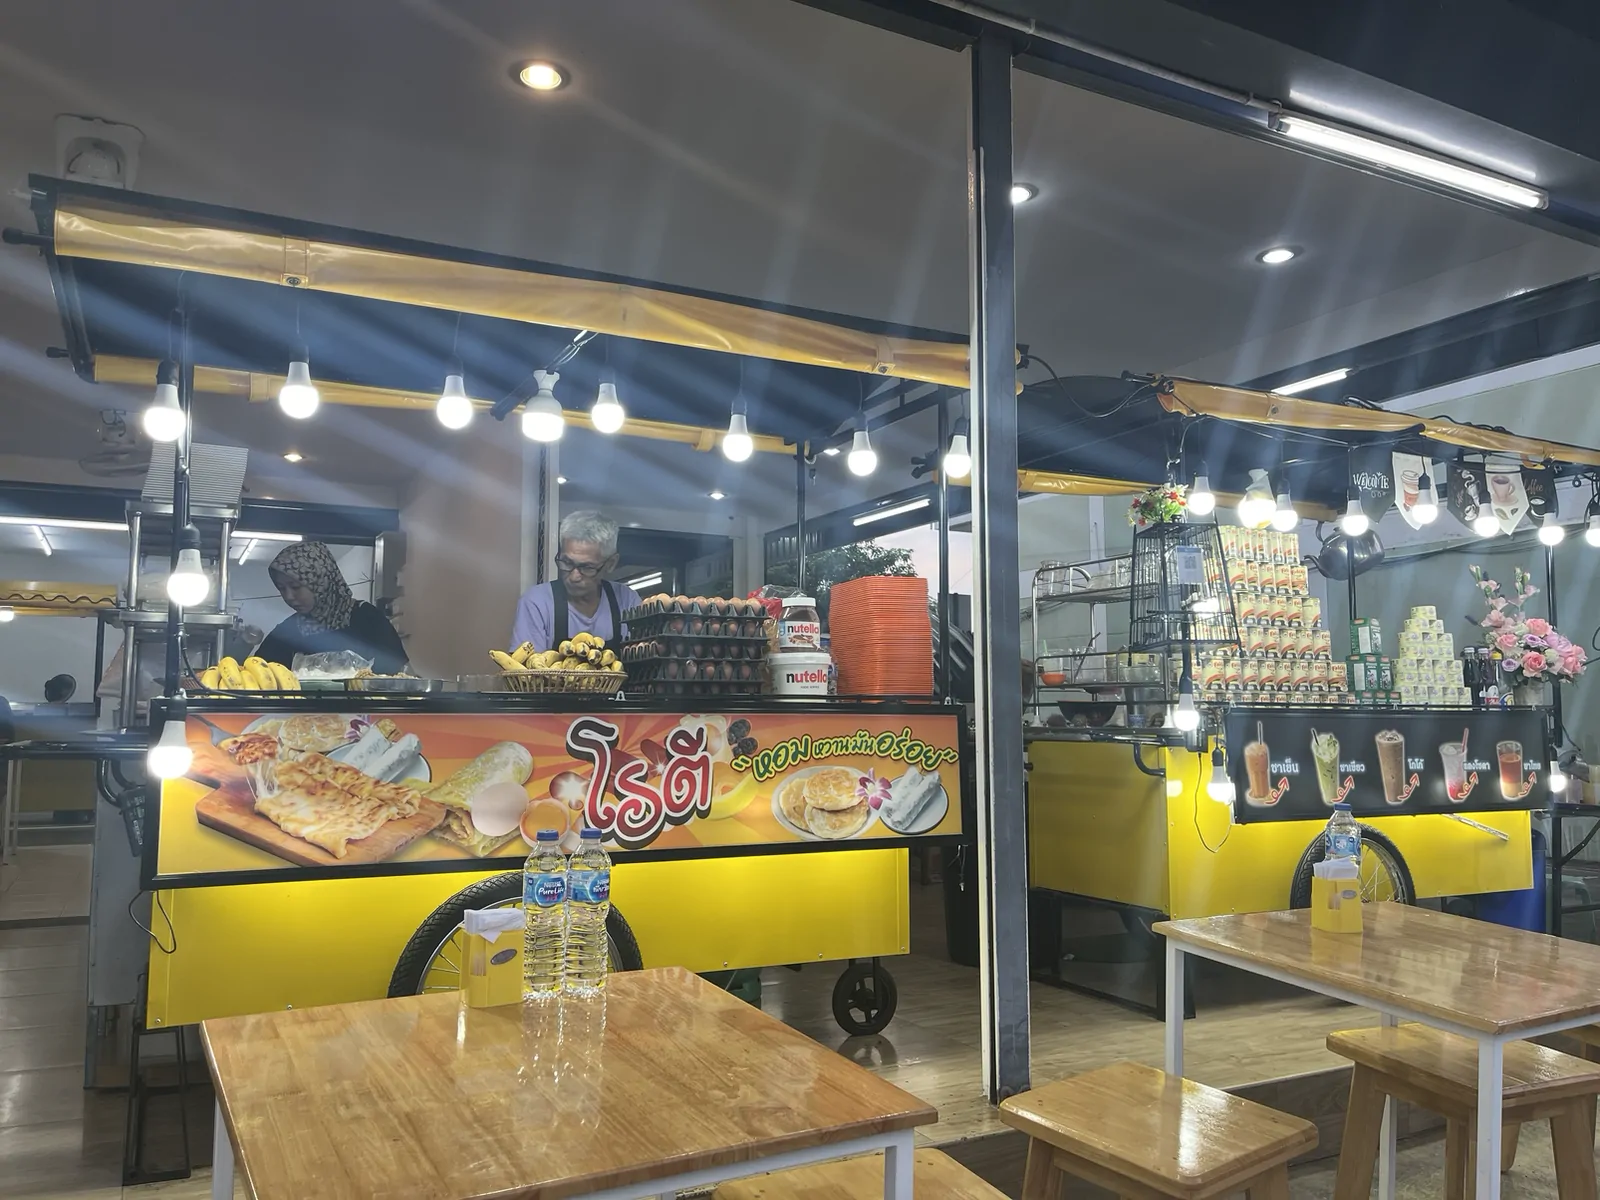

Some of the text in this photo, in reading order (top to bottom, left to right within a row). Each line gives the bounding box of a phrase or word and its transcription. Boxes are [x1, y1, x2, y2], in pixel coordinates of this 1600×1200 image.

[787, 624, 819, 634] nutella
[1270, 757, 1299, 773] ชาเย็น
[567, 716, 712, 846] โรตี
